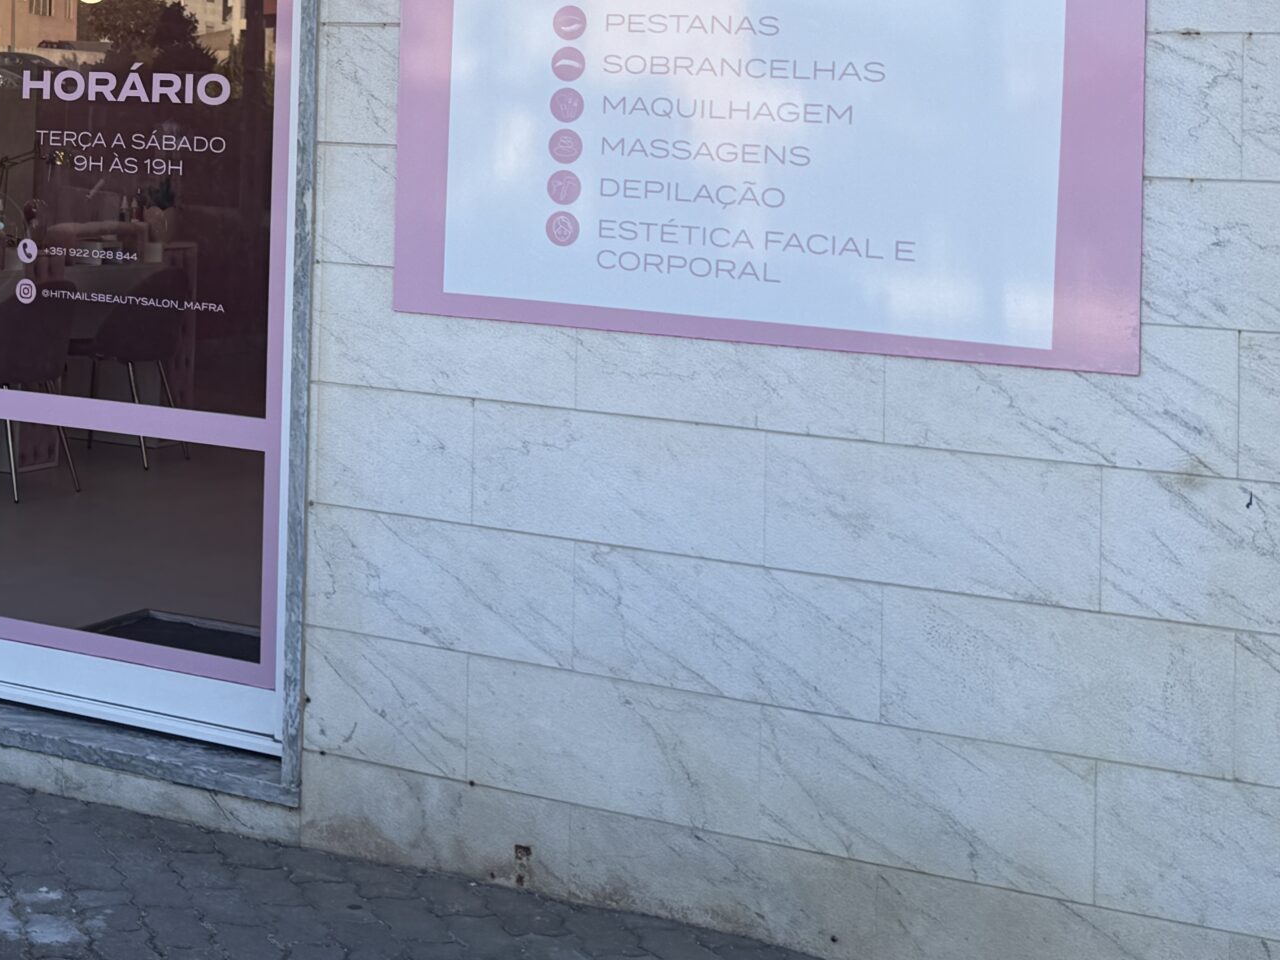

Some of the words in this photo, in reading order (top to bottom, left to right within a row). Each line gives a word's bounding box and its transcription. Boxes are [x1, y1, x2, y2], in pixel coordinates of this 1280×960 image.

[605, 13, 780, 36] PESTANAS
[602, 54, 886, 83] SOBRANCELHAS
[22, 62, 231, 106] HORÁRIO
[602, 95, 854, 125] MAQUILHAGEM
[36, 129, 106, 150] TERÇA
[111, 133, 126, 149] A
[131, 129, 226, 153] SÁBADO
[600, 137, 811, 167] MASSAGENS
[73, 155, 103, 172] 9H
[109, 152, 138, 173] ÀS
[143, 158, 183, 176] 19H
[599, 178, 785, 210] DEPILAÇÃO
[43, 246, 67, 256] +351
[69, 248, 89, 258] 922
[91, 249, 113, 259] 028
[115, 251, 138, 261] 844
[597, 218, 754, 250] ESTÉTICA
[765, 231, 884, 260] FACIAL
[895, 240, 916, 262] E
[596, 249, 781, 283] CORPORAL
[41, 288, 225, 313] @HITNAILSBEAUTYSALON_MAFRA
